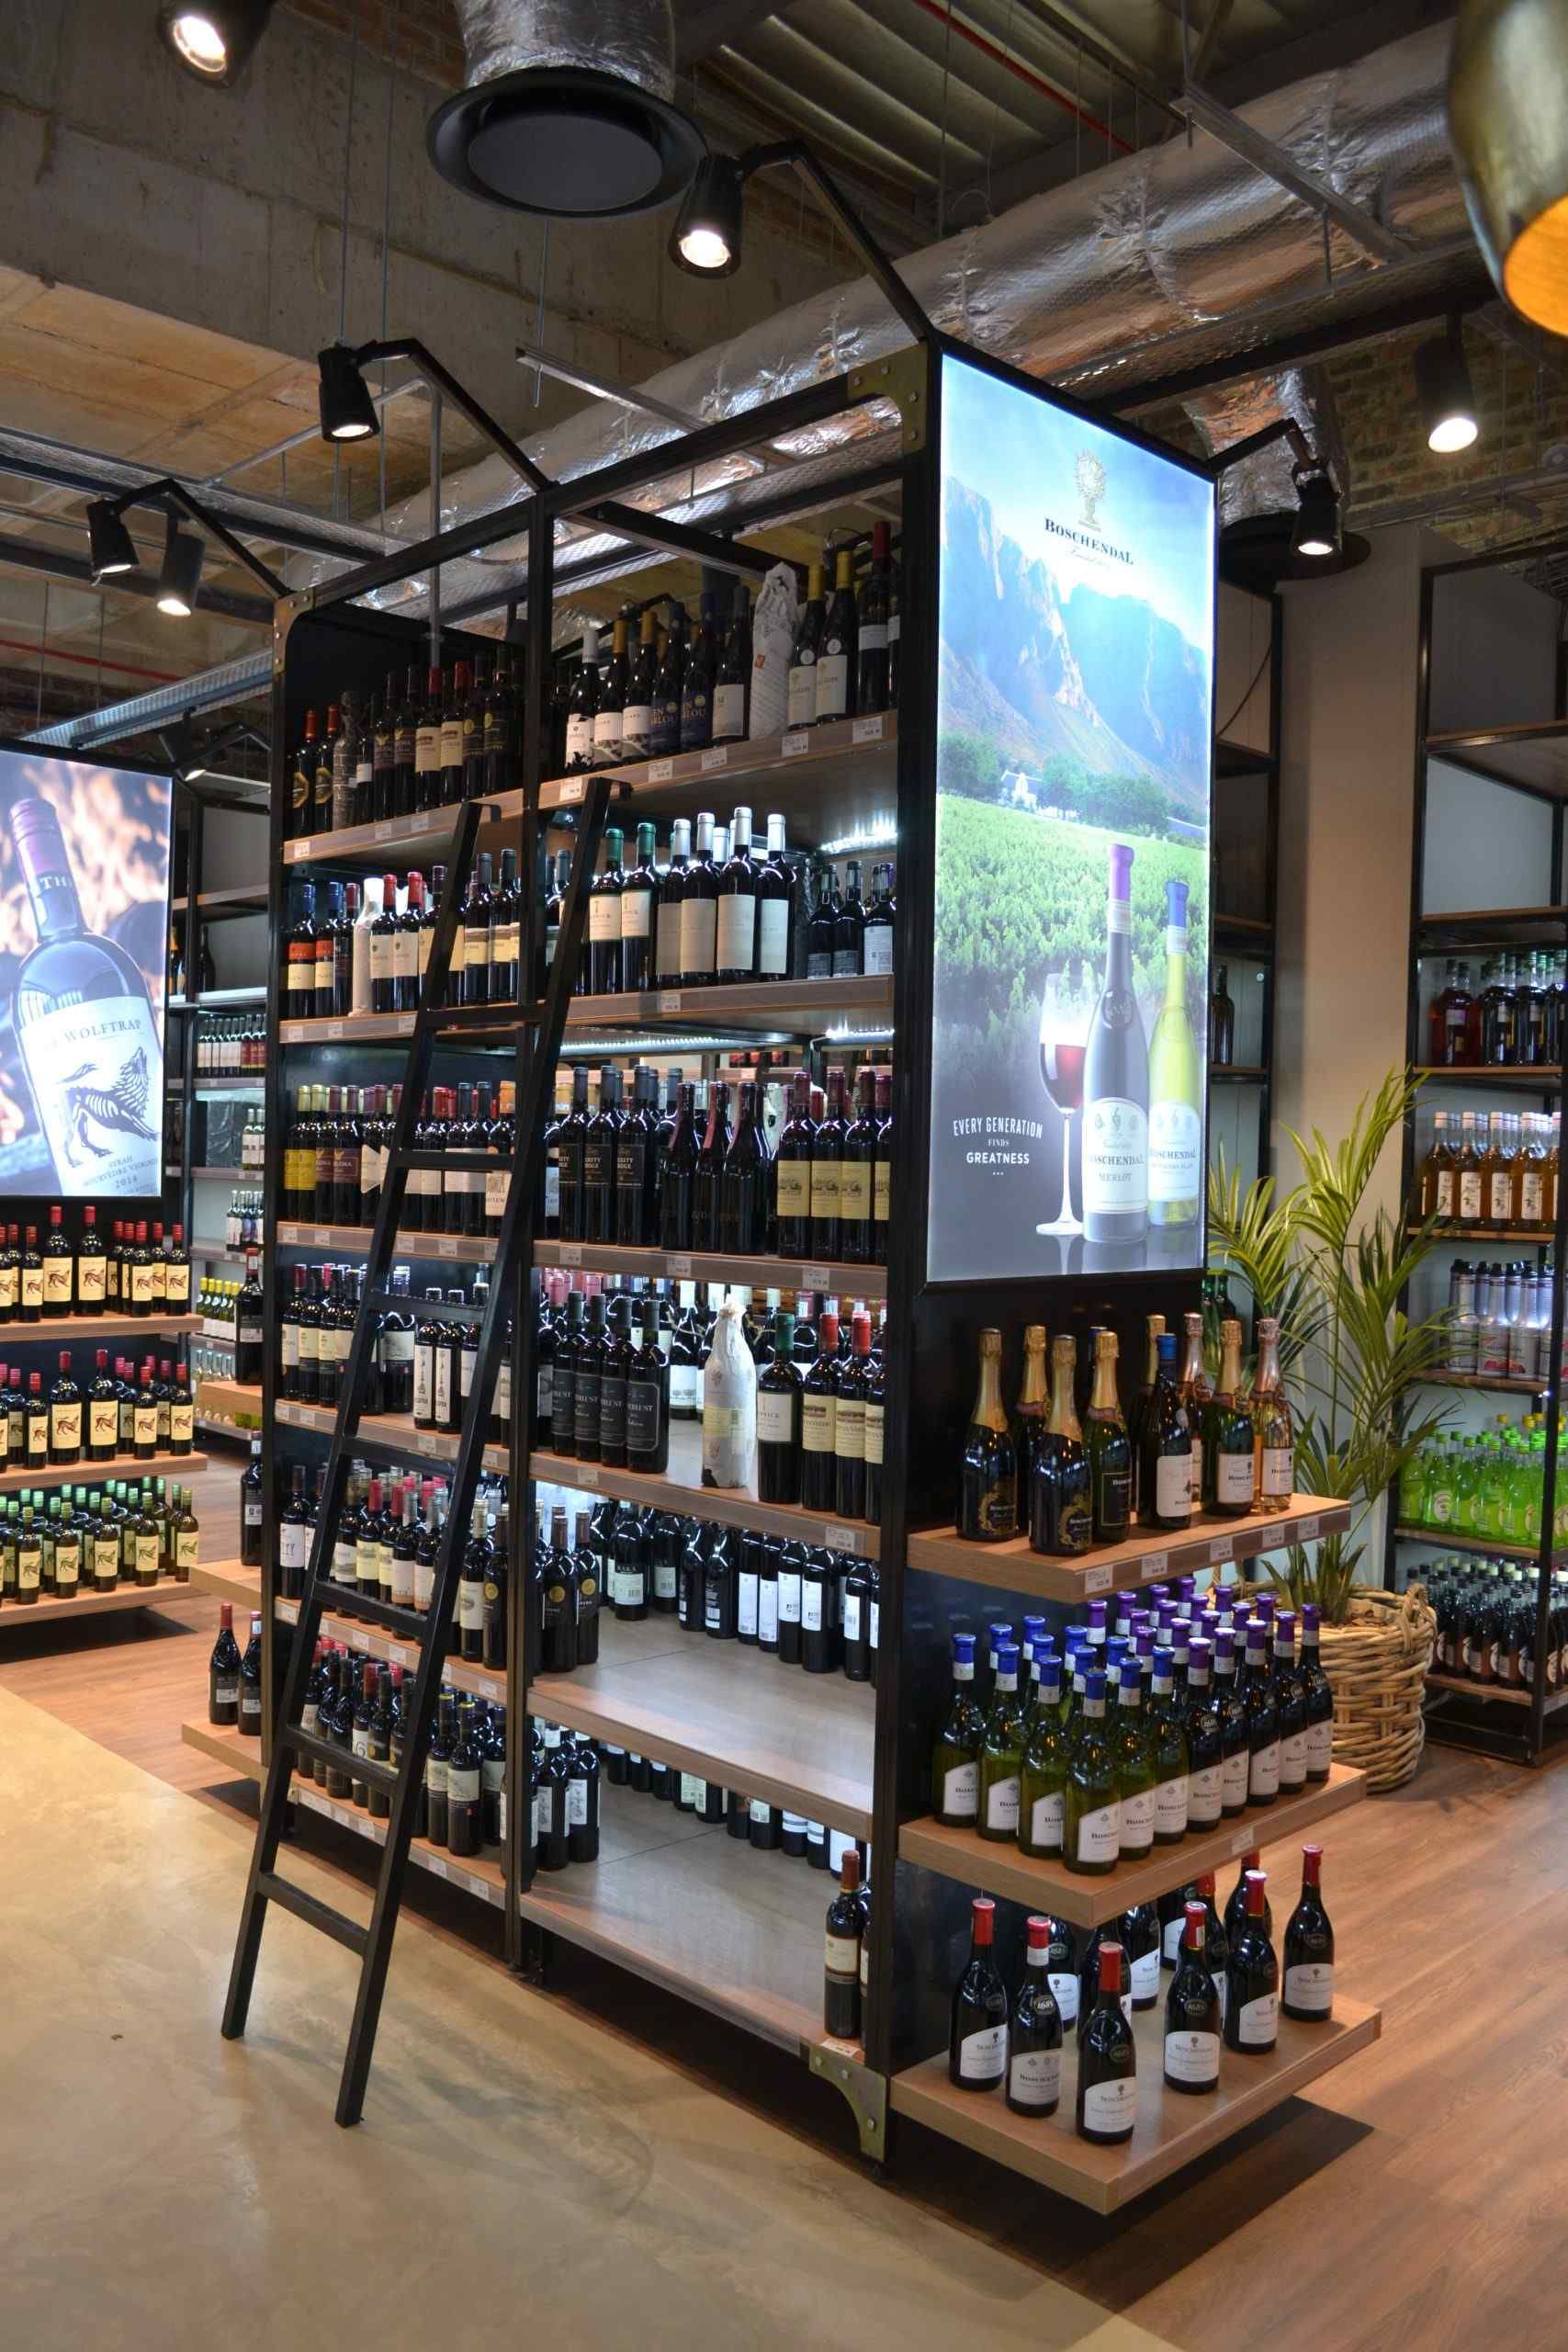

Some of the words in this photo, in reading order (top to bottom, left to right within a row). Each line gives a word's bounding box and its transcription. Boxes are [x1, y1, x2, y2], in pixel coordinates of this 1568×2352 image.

[1044, 517, 1134, 565] BOSCHENDAL
[953, 1117, 982, 1136] EVERY
[986, 1116, 1043, 1139] GENERATION
[987, 1138, 1010, 1148] FINDS
[965, 1151, 1030, 1165] GREATNESS
